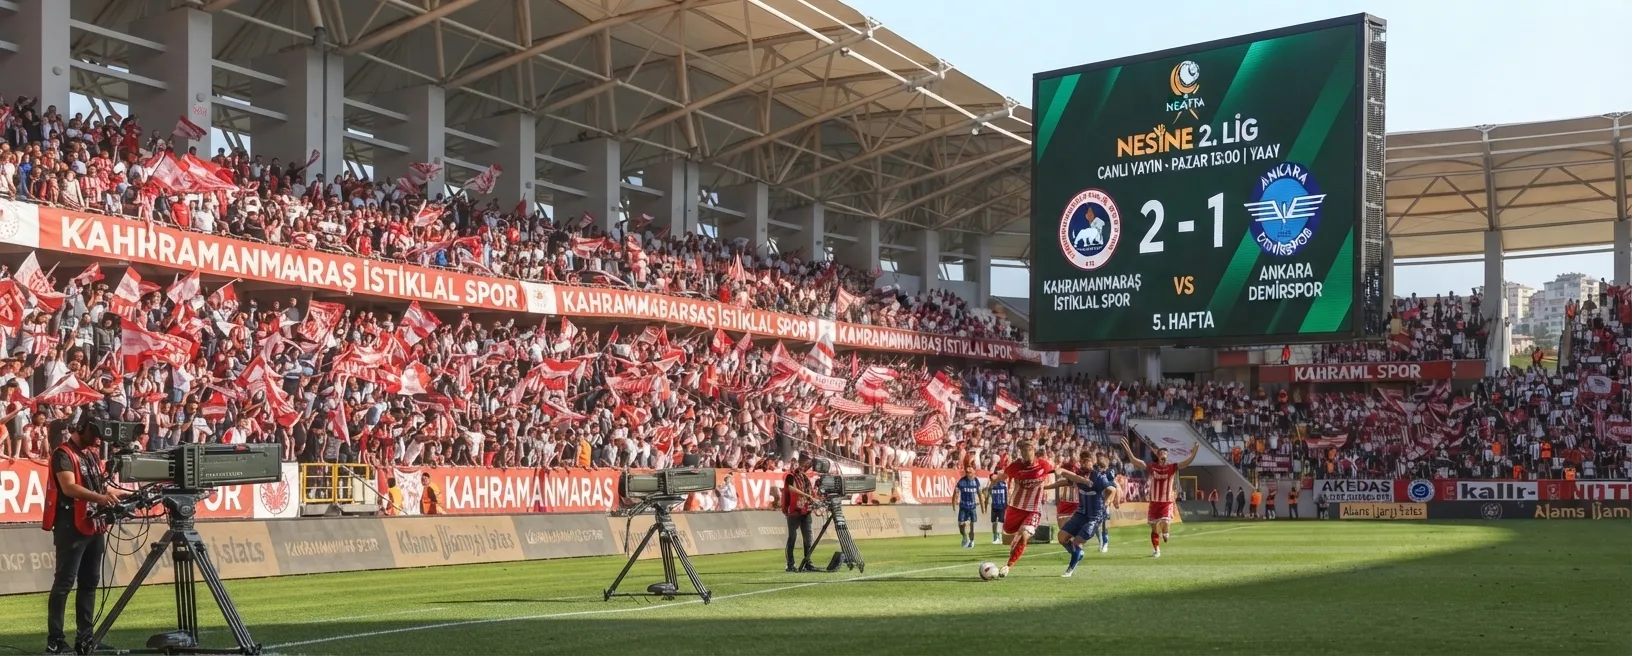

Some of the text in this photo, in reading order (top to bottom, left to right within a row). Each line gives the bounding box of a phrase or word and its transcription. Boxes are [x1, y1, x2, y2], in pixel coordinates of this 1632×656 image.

[1198, 124, 1218, 147] 2.
[1222, 113, 1258, 143] LİG
[1097, 162, 1128, 179] CANLI
[1130, 159, 1163, 175] YAYIN
[1171, 154, 1208, 171] PAZAR
[1249, 143, 1281, 161] YAAY
[1139, 199, 1165, 254] 2
[1208, 193, 1224, 248] 1
[1259, 262, 1313, 281] ANKARA
[363, 260, 460, 302] İSTİKLAL
[465, 279, 518, 308] SPOR
[1043, 273, 1142, 295] KAHRAMANMARAŞ
[1173, 275, 1195, 295] VS
[1248, 280, 1323, 301] DEMİRSPOR
[1101, 292, 1131, 309] SPOR
[1152, 310, 1215, 331] 5. HAFTA
[1376, 364, 1422, 379] SPOR
